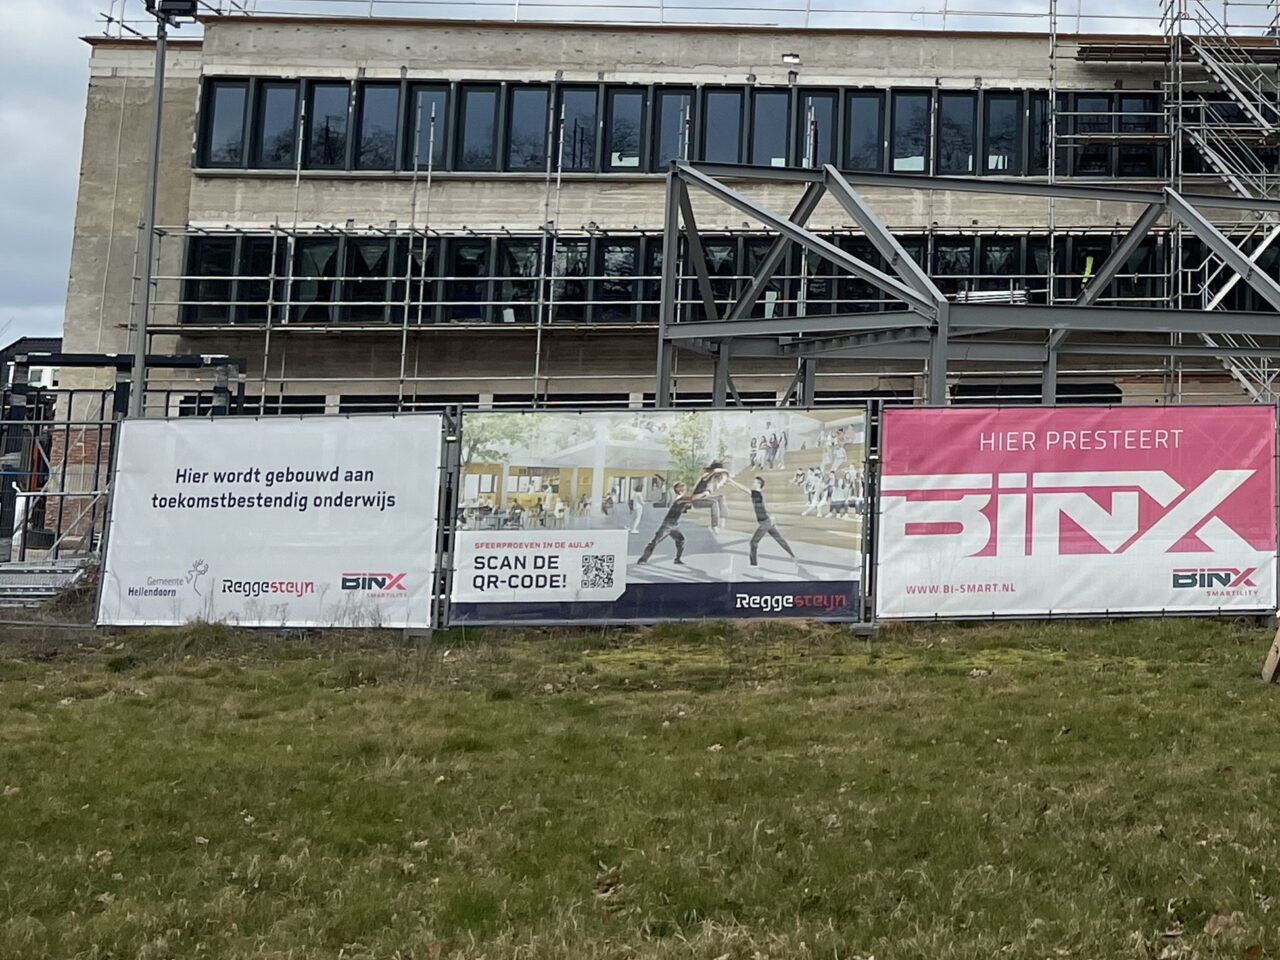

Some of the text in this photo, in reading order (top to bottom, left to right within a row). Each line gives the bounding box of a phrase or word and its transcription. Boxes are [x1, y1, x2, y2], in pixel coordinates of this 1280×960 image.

[979, 429, 1184, 451] HIER PRESTEERT
[175, 466, 374, 487] Hier wordt gebouwd aan
[152, 491, 396, 512] toekomstbestendig onderwijs
[880, 469, 1259, 556] BINX
[554, 541, 566, 549] DE
[567, 541, 595, 549] AULA?
[474, 555, 560, 570] SCAN DE
[147, 576, 184, 586] Gemeente
[341, 573, 407, 590] BINX
[472, 574, 567, 591] QR-CODE!
[1173, 568, 1257, 588] BINX
[128, 587, 177, 597] Hellendoorn
[222, 579, 315, 598] Reggesteyn
[906, 583, 1017, 595] WWW.BI-SMART.NL
[736, 594, 848, 612] Reggesteyn
